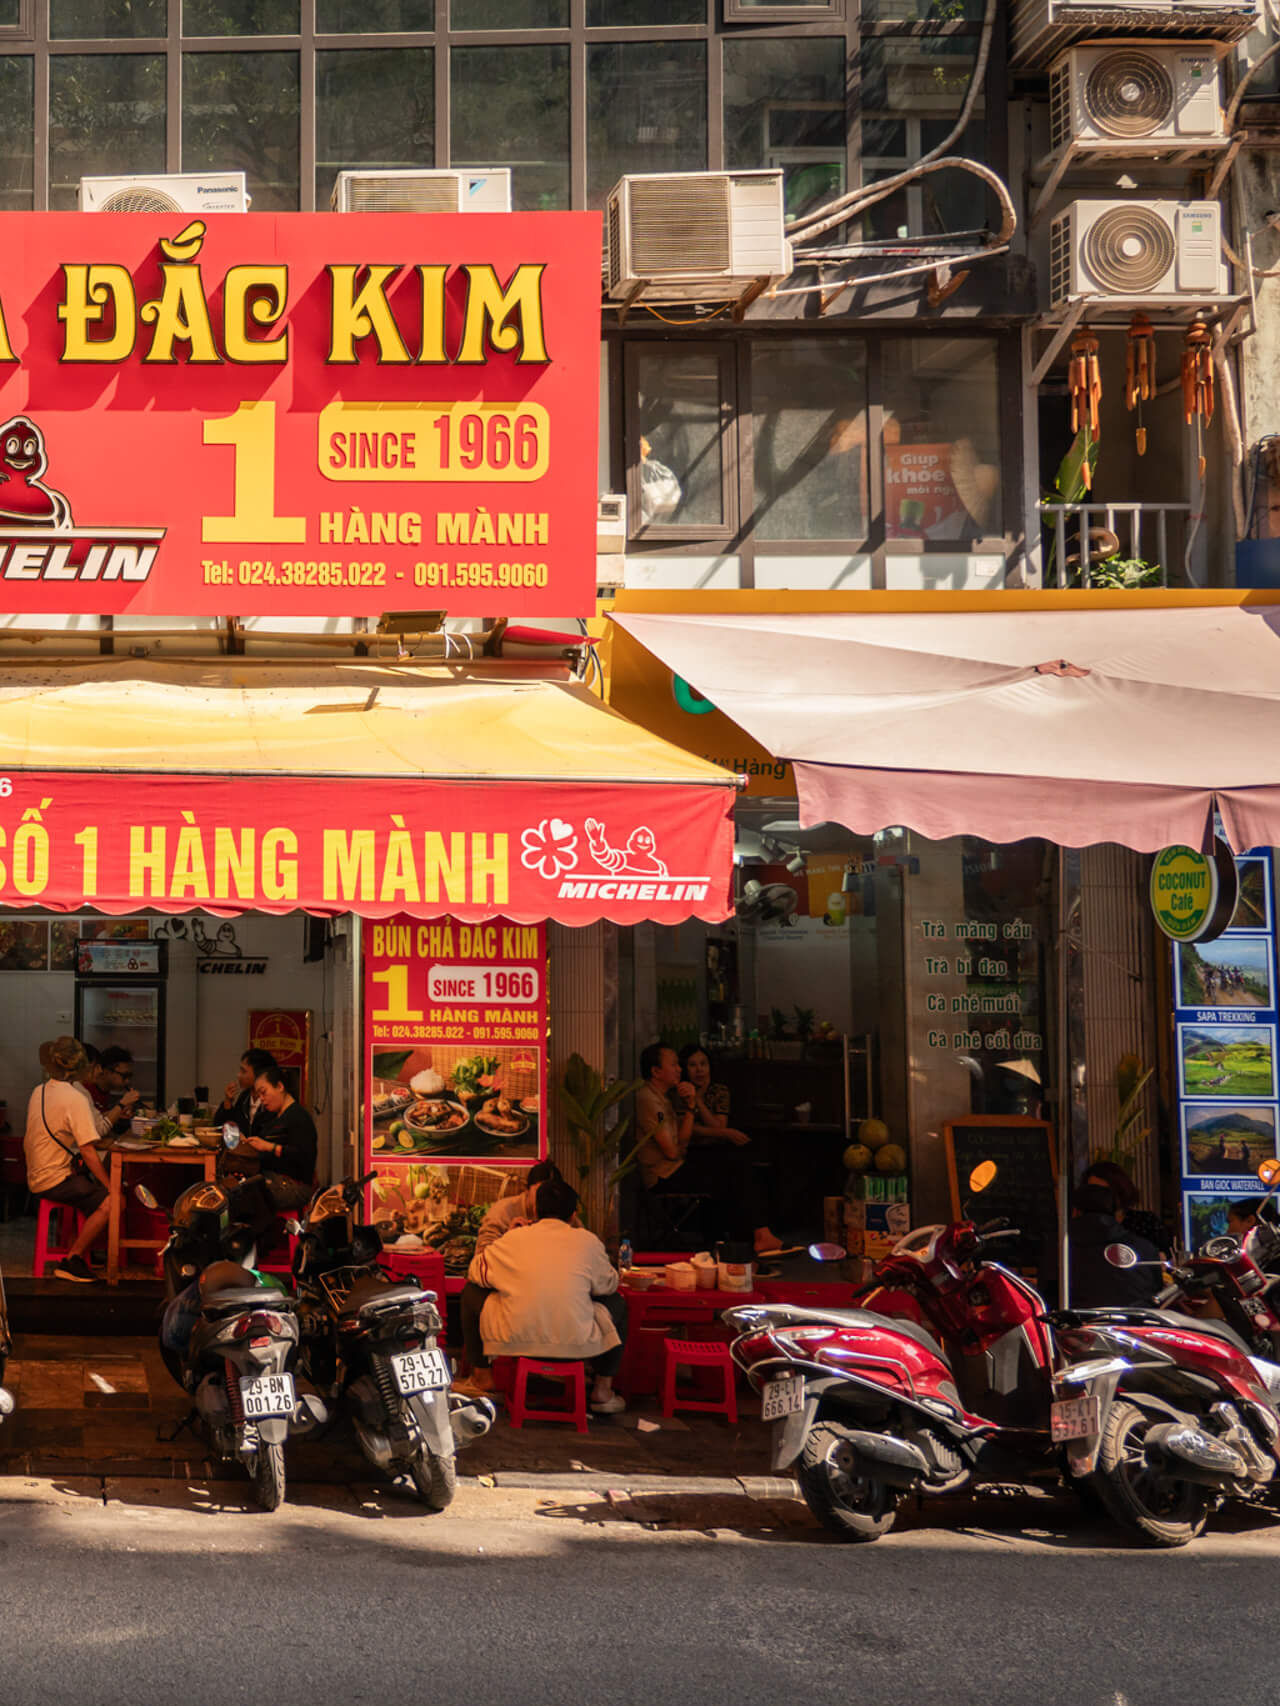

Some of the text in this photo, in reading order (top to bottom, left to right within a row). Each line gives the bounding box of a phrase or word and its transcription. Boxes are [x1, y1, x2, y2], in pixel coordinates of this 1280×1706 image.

[197, 185, 239, 194] Panasonic
[57, 220, 289, 365] ĐẮC
[325, 263, 552, 365] KIM
[329, 414, 539, 470] SINCE 1966
[202, 400, 306, 544] 1
[319, 506, 549, 545] HÀNG MÀNH
[201, 559, 233, 585] Tel:
[239, 561, 386, 586] 024.38285.022
[414, 562, 549, 587] 091.595.9060
[74, 825, 99, 897] 1
[129, 810, 299, 901] HÀNG
[322, 813, 510, 905] MÀNH
[1158, 871, 1206, 890] COCONUT
[557, 882, 709, 901] MICHELIN
[1171, 892, 1194, 911] Café
[372, 918, 412, 958] BÚN
[417, 915, 454, 959] CHẢ
[502, 927, 539, 959] KIM
[921, 919, 946, 938] Trà
[924, 956, 949, 975] Trà
[372, 964, 424, 1022] 1
[433, 972, 534, 998] SINCE 1966
[951, 992, 979, 1014] phê
[429, 1006, 539, 1024] HÀNG MÀNH
[1197, 1012, 1256, 1023] SAPA TREKKING
[372, 1025, 388, 1038] Tel:
[953, 1030, 982, 1053] phê
[1200, 1179, 1214, 1190] BAN
[400, 1356, 437, 1373] 29-L1
[248, 1376, 285, 1395] 29-BN
[400, 1368, 444, 1391] 576.27
[246, 1394, 291, 1414] 001.26
[764, 1395, 800, 1417] 666.14
